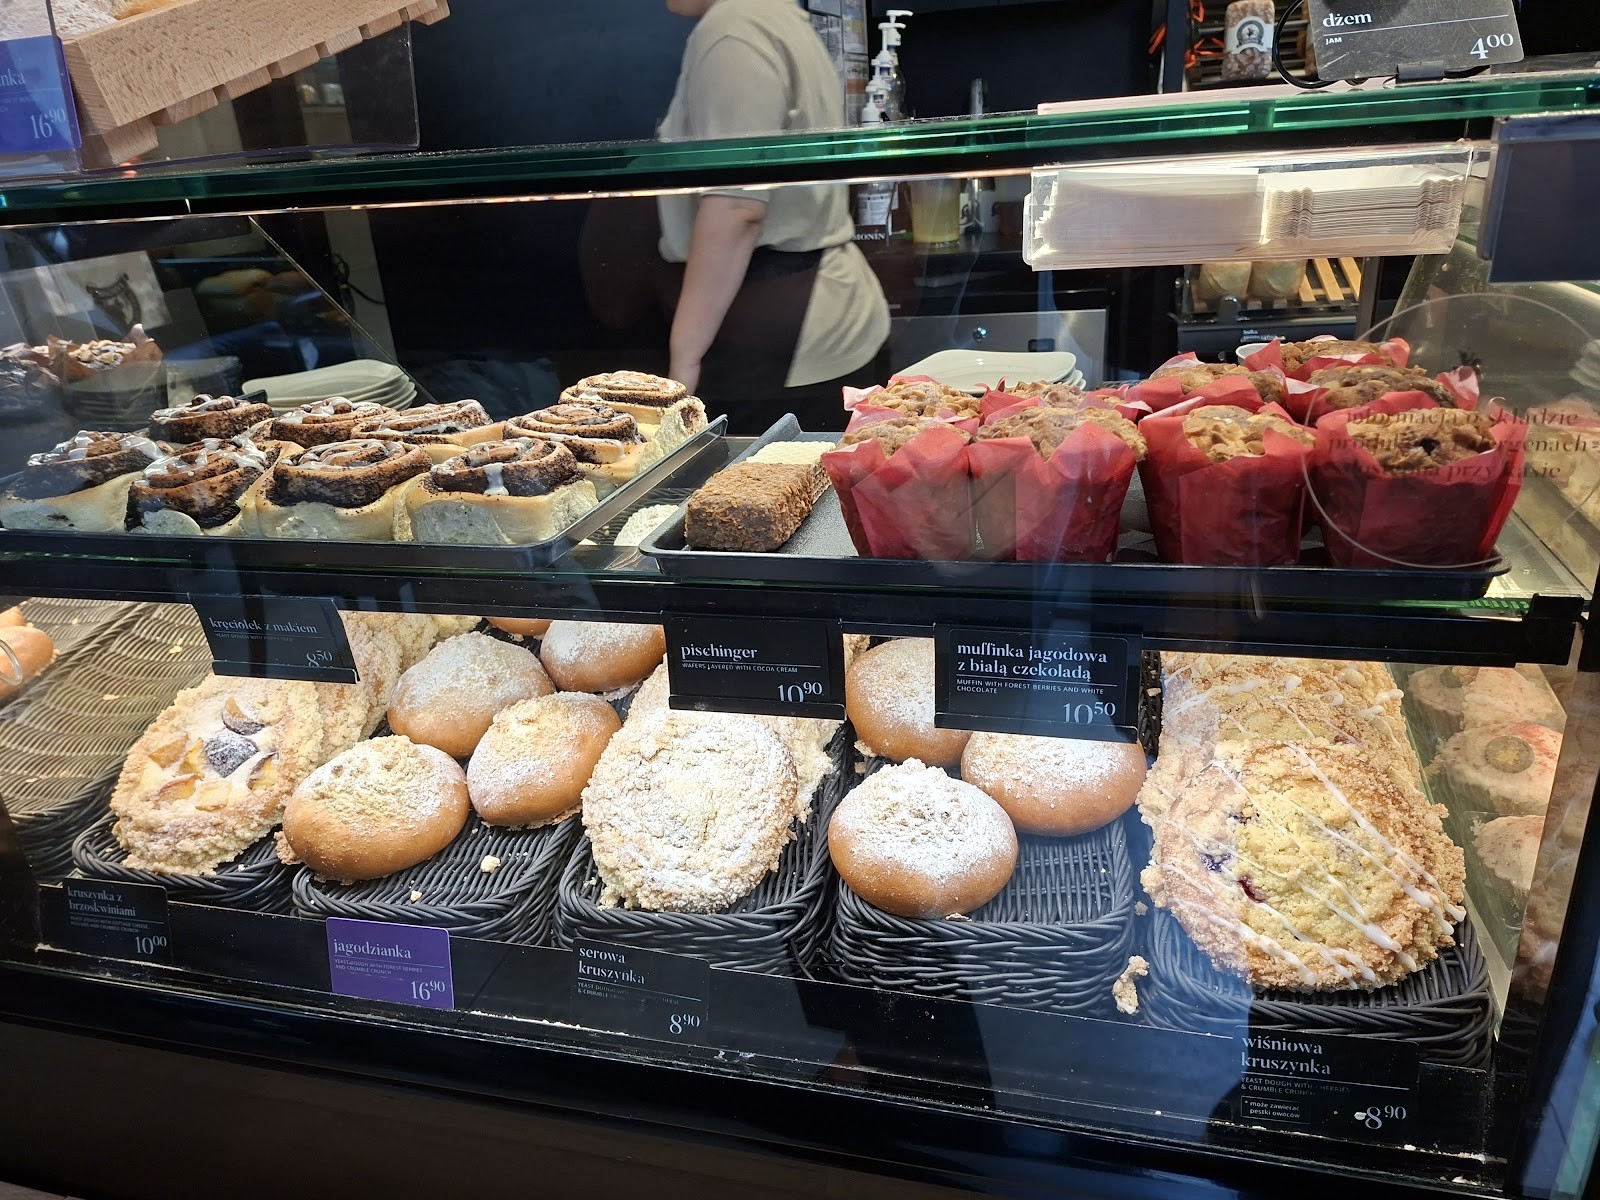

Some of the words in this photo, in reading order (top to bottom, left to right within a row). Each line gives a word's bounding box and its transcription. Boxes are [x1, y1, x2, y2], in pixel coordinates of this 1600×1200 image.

[1322, 13, 1372, 28] dżem
[1325, 37, 1343, 46] JAM
[273, 621, 318, 633] makiem
[681, 643, 758, 661] pischinger
[957, 642, 1024, 658] muffinka
[1028, 645, 1108, 663] jagodowa
[957, 660, 966, 671] z
[1012, 663, 1092, 682] czekoladą
[956, 685, 998, 694] CHOCOLATE
[1004, 681, 1031, 690] FOREST
[1032, 684, 1061, 692] BERRIES
[1081, 687, 1104, 695] WHITE
[67, 886, 115, 902] kruszynka
[117, 894, 122, 902] z
[69, 899, 136, 917] brzoskwiniami
[333, 939, 412, 959] jagodzianka
[579, 947, 626, 964] serowa
[578, 961, 645, 985] kruszynka
[1242, 1035, 1323, 1055] wiśniowa
[1241, 1052, 1331, 1075] kruszynka
[1241, 1076, 1263, 1084] YEAST
[1264, 1079, 1292, 1087] DOUGH
[1248, 1084, 1283, 1094] CRUMBLE
[1249, 1108, 1271, 1116] pestki
[1250, 1100, 1269, 1109] może
